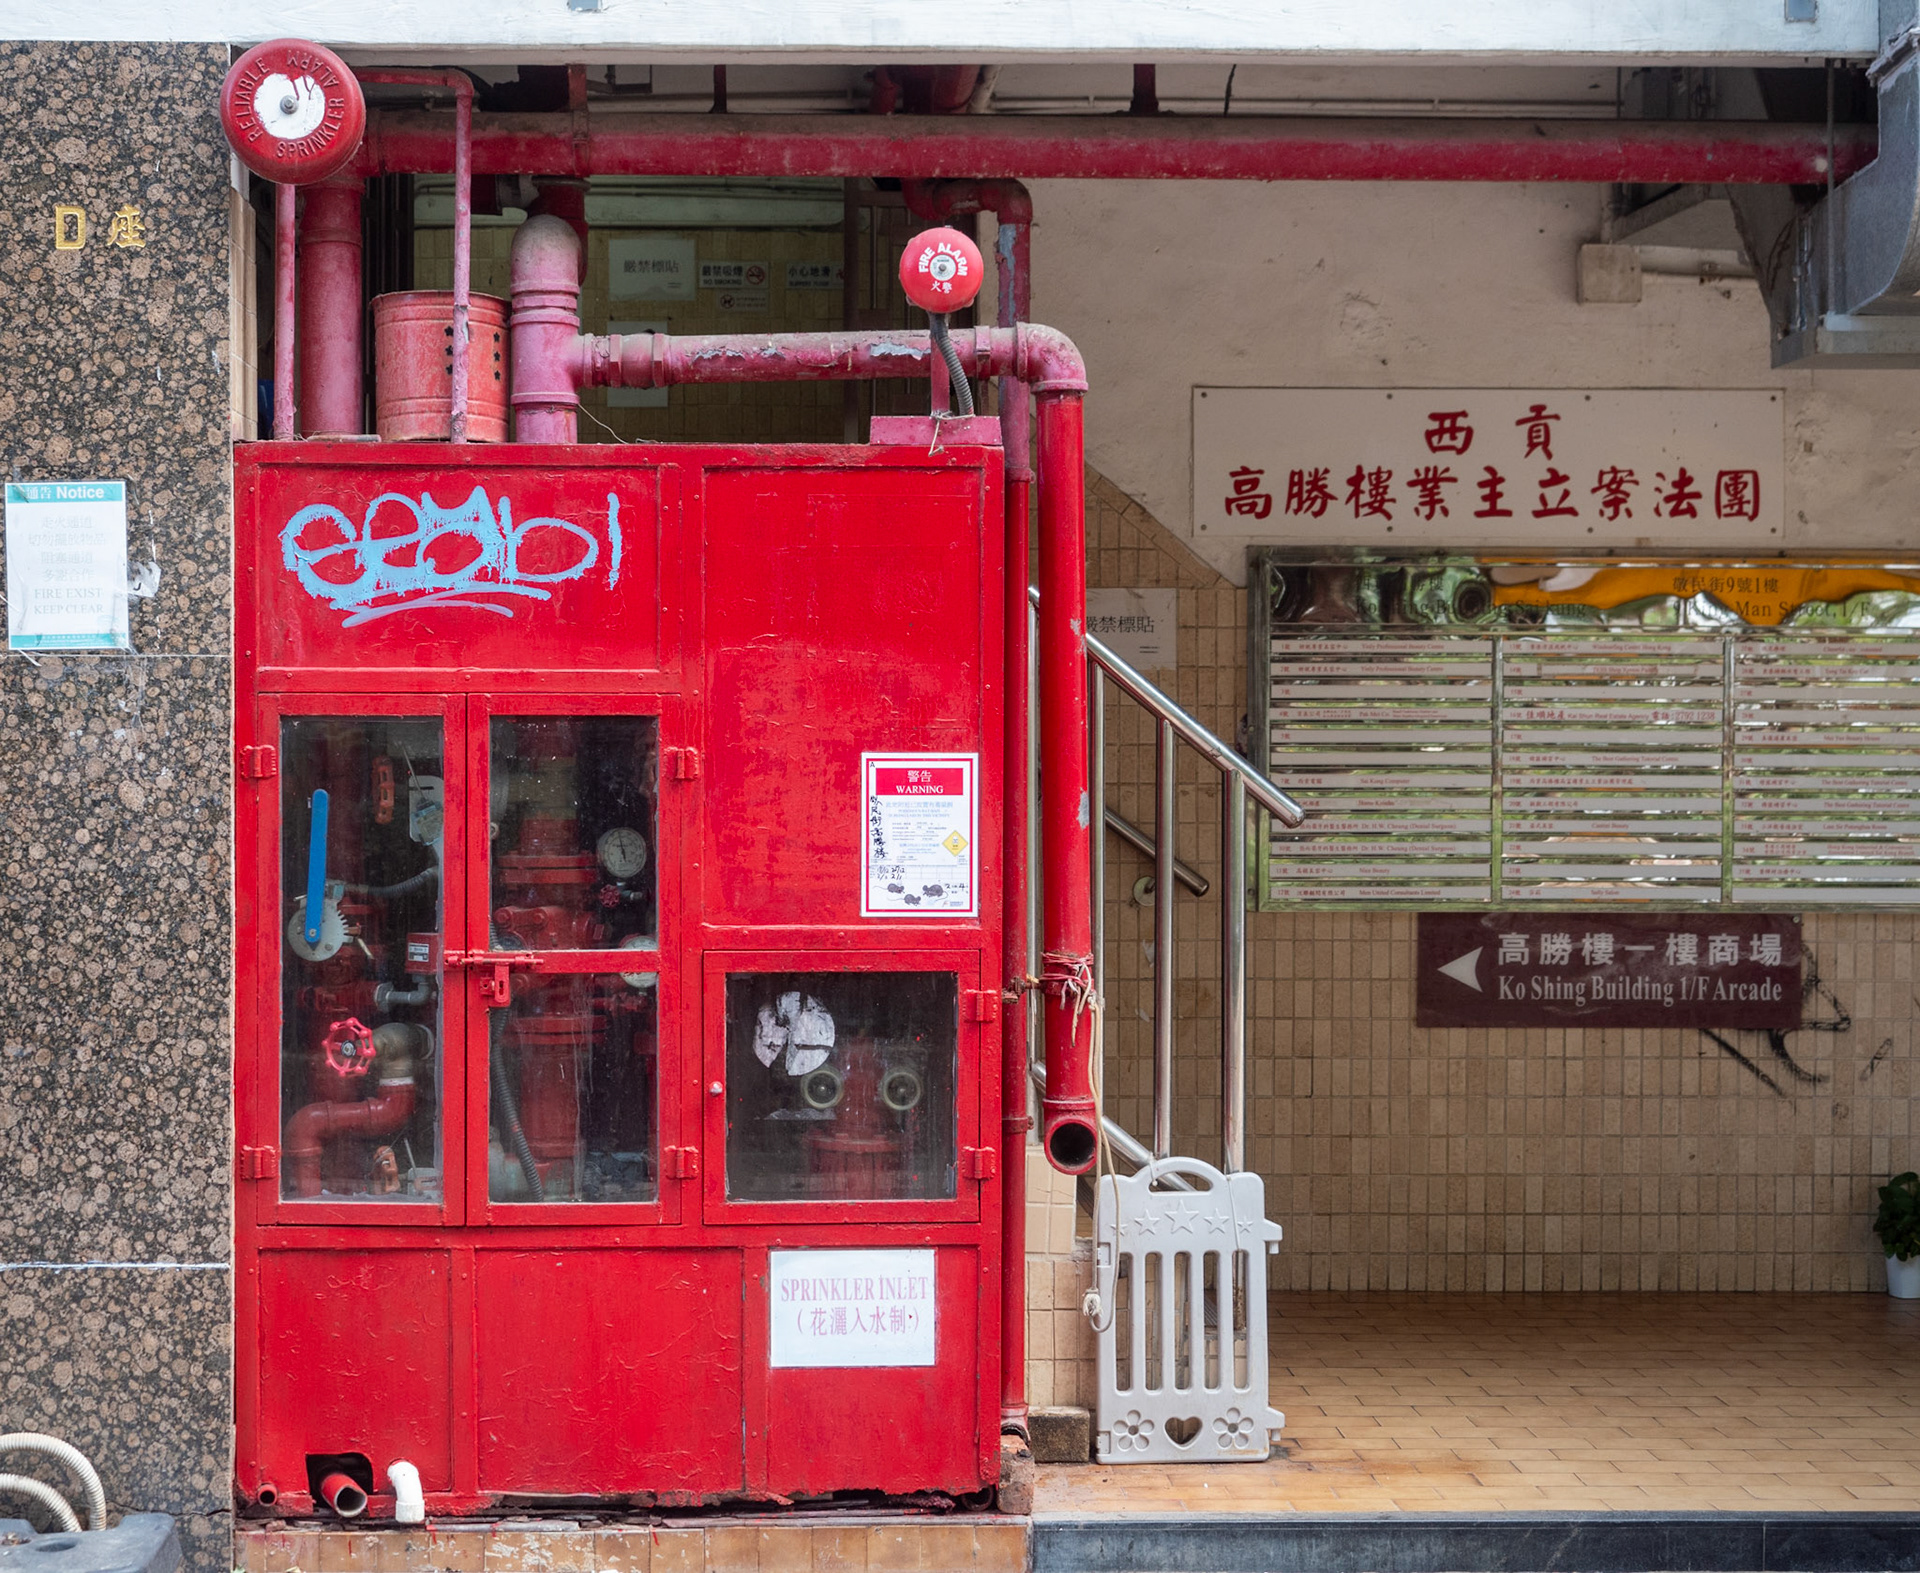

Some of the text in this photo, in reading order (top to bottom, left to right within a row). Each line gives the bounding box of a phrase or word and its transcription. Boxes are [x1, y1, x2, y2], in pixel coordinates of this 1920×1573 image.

[235, 57, 270, 142] RELIABLE
[276, 50, 345, 158] SPRINKLER ALARM
[55, 204, 146, 249] D座
[624, 259, 680, 274] 嚴禁標貼
[918, 242, 968, 277] FIRE ALARM
[788, 265, 831, 277] 小心地滑
[1424, 404, 1561, 460] 西貢
[26, 486, 105, 499] 通告 Notice
[1224, 464, 1760, 521] 高勝樓業主立案法團
[34, 587, 103, 599] FIRE EXIST
[1672, 577, 1779, 593] 敬民街9號1樓
[34, 604, 105, 615] KEEP CLEAR
[1735, 601, 1772, 617] Man
[907, 770, 932, 783] 警告
[1384, 778, 1410, 786] Computer
[896, 785, 944, 794] WARNING
[1498, 932, 1782, 967] 高勝樓一樓商場
[1499, 975, 1782, 1007] Ko Shing Building 1/F Arcade
[781, 1275, 928, 1301] SPRINKLER INLET
